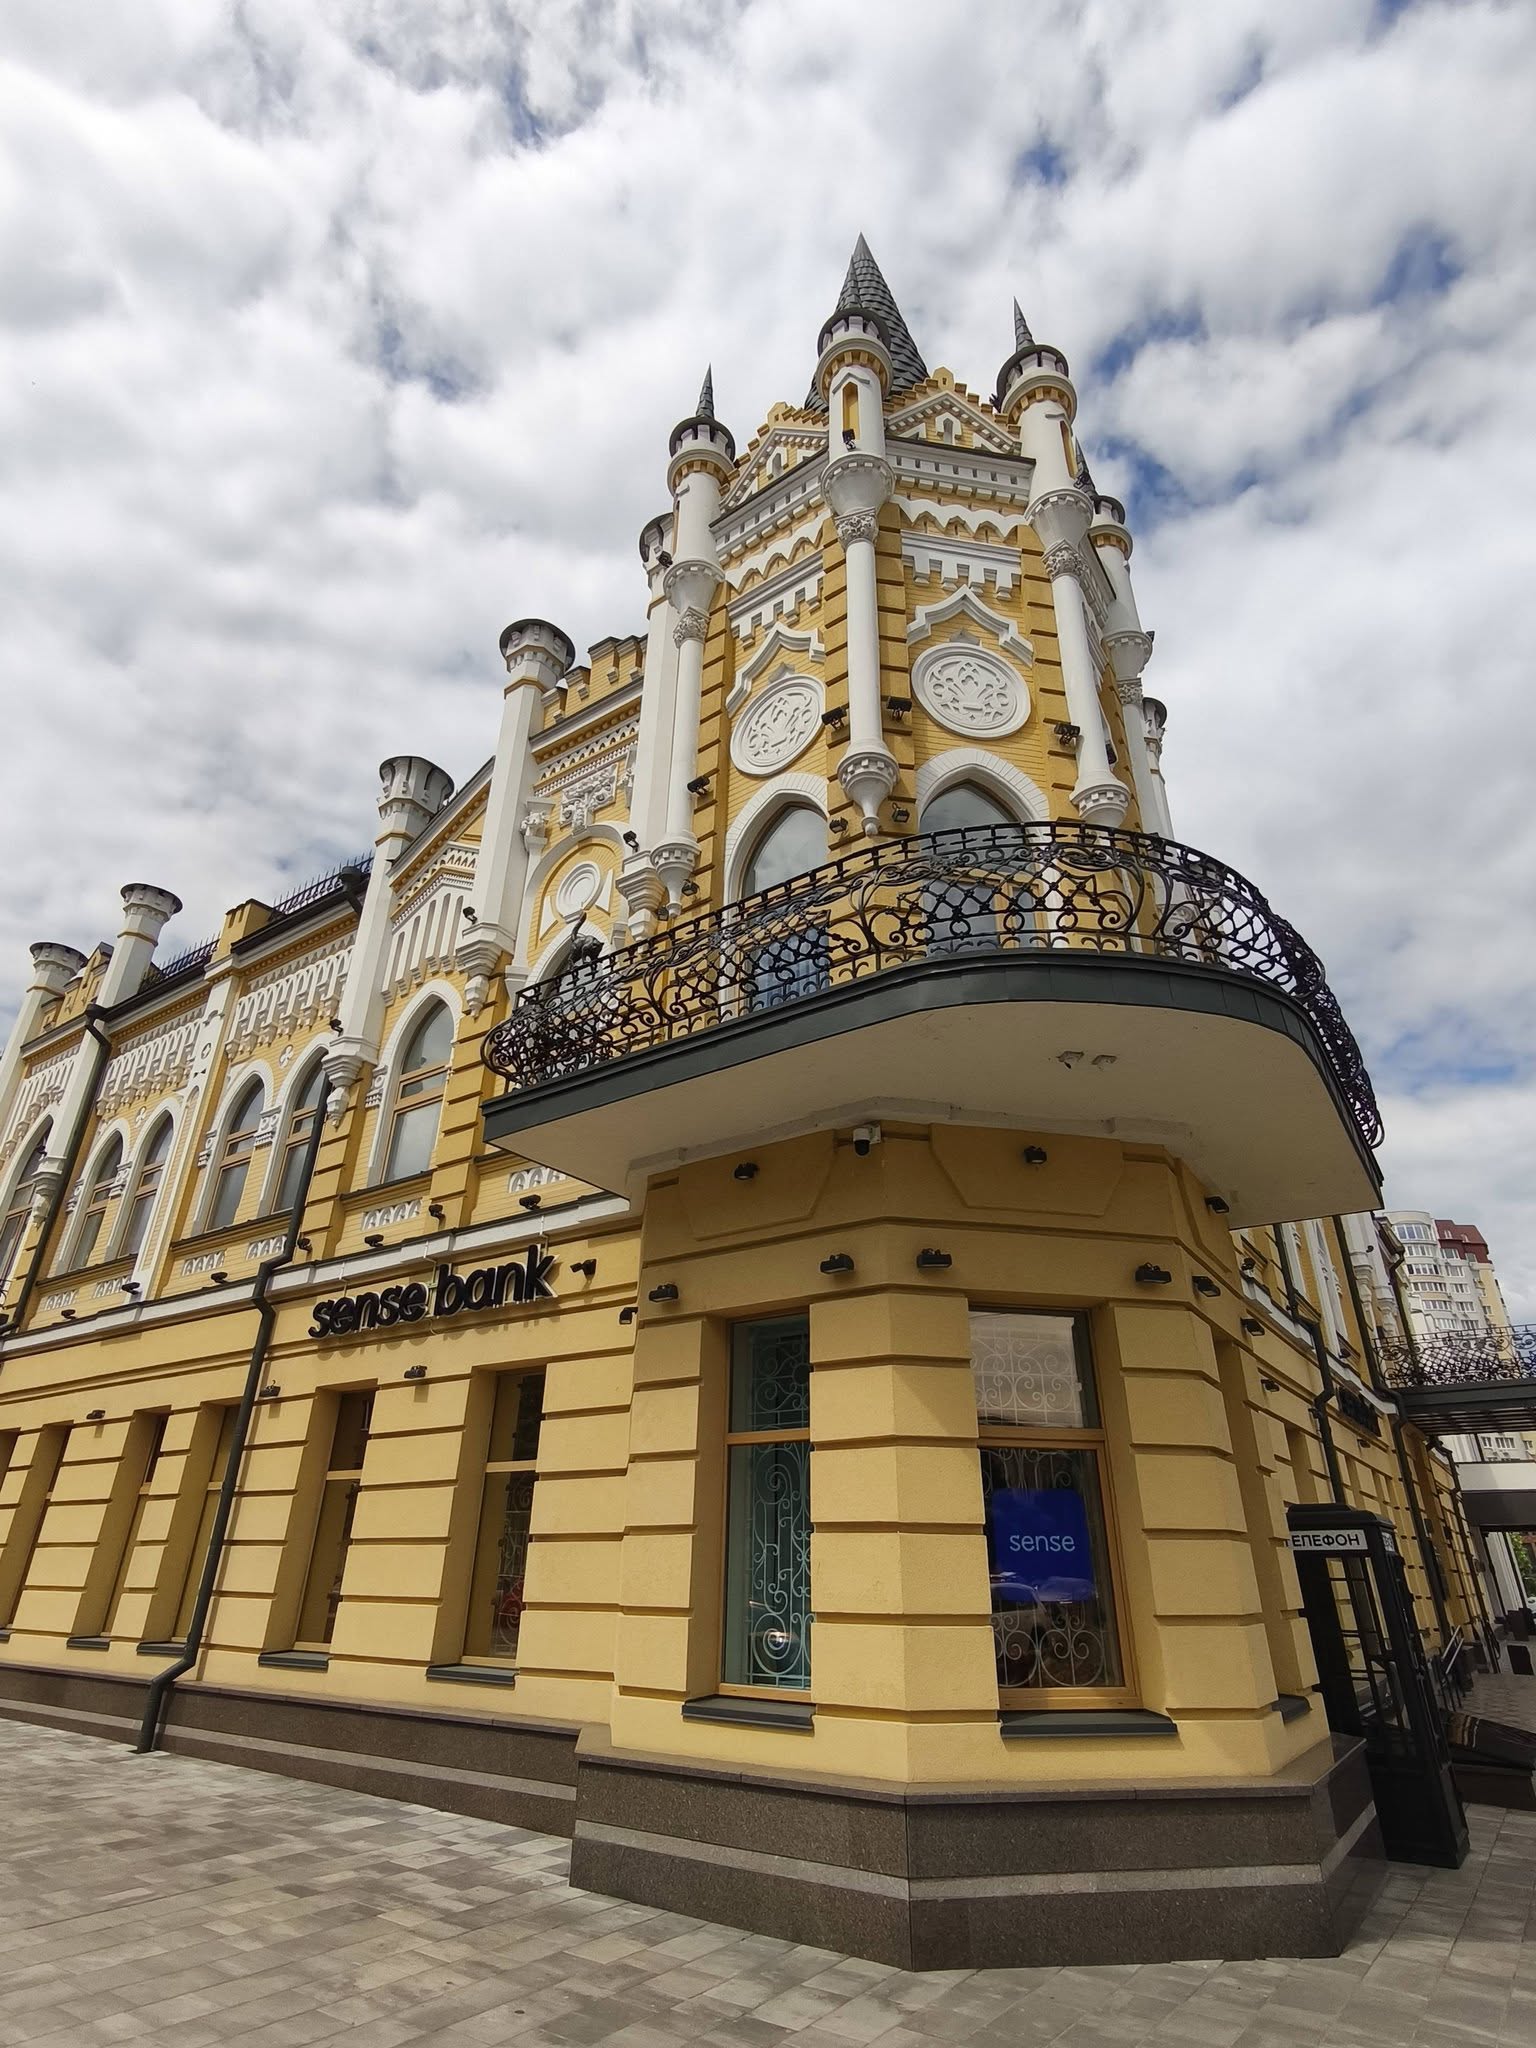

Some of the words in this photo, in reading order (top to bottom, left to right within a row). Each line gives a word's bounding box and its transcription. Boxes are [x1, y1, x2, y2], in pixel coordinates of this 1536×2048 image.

[308, 1282, 428, 1339] sense
[434, 1244, 558, 1317] bank
[1009, 1534, 1076, 1552] sense
